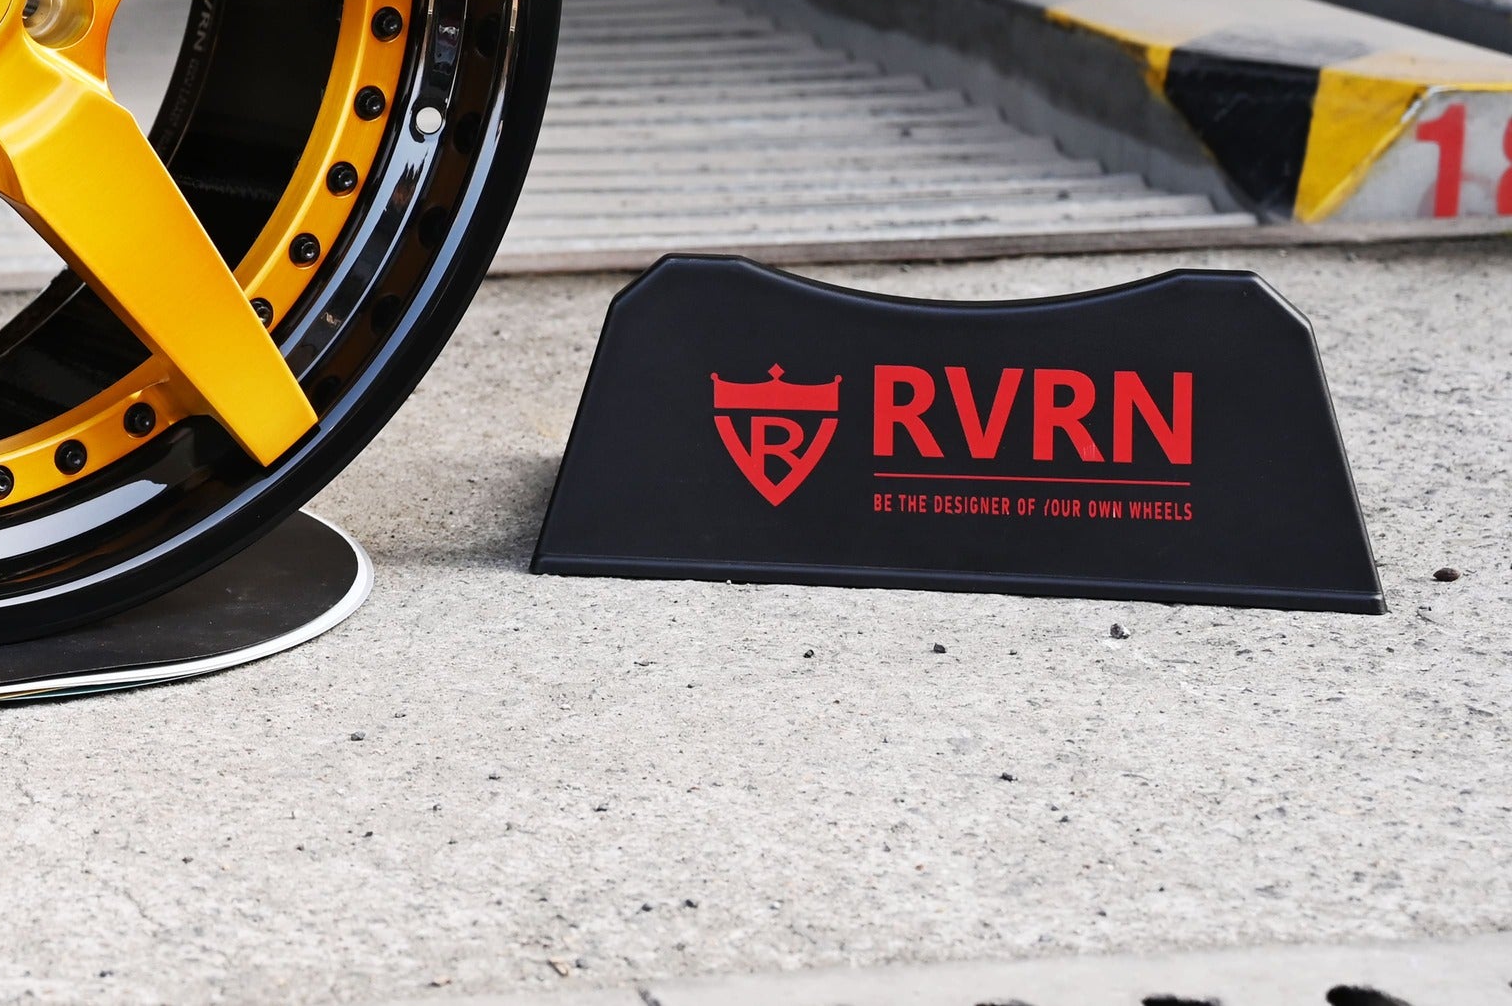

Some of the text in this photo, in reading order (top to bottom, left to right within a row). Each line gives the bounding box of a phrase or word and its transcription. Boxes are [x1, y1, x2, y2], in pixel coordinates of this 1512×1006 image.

[873, 364, 1193, 465] RVRN
[873, 493, 892, 512] BE
[898, 494, 928, 513] THE
[934, 495, 1010, 515] DESIGNER
[1017, 497, 1036, 516] OF
[1088, 500, 1123, 519] OWN
[1129, 501, 1193, 521] WHEELS
